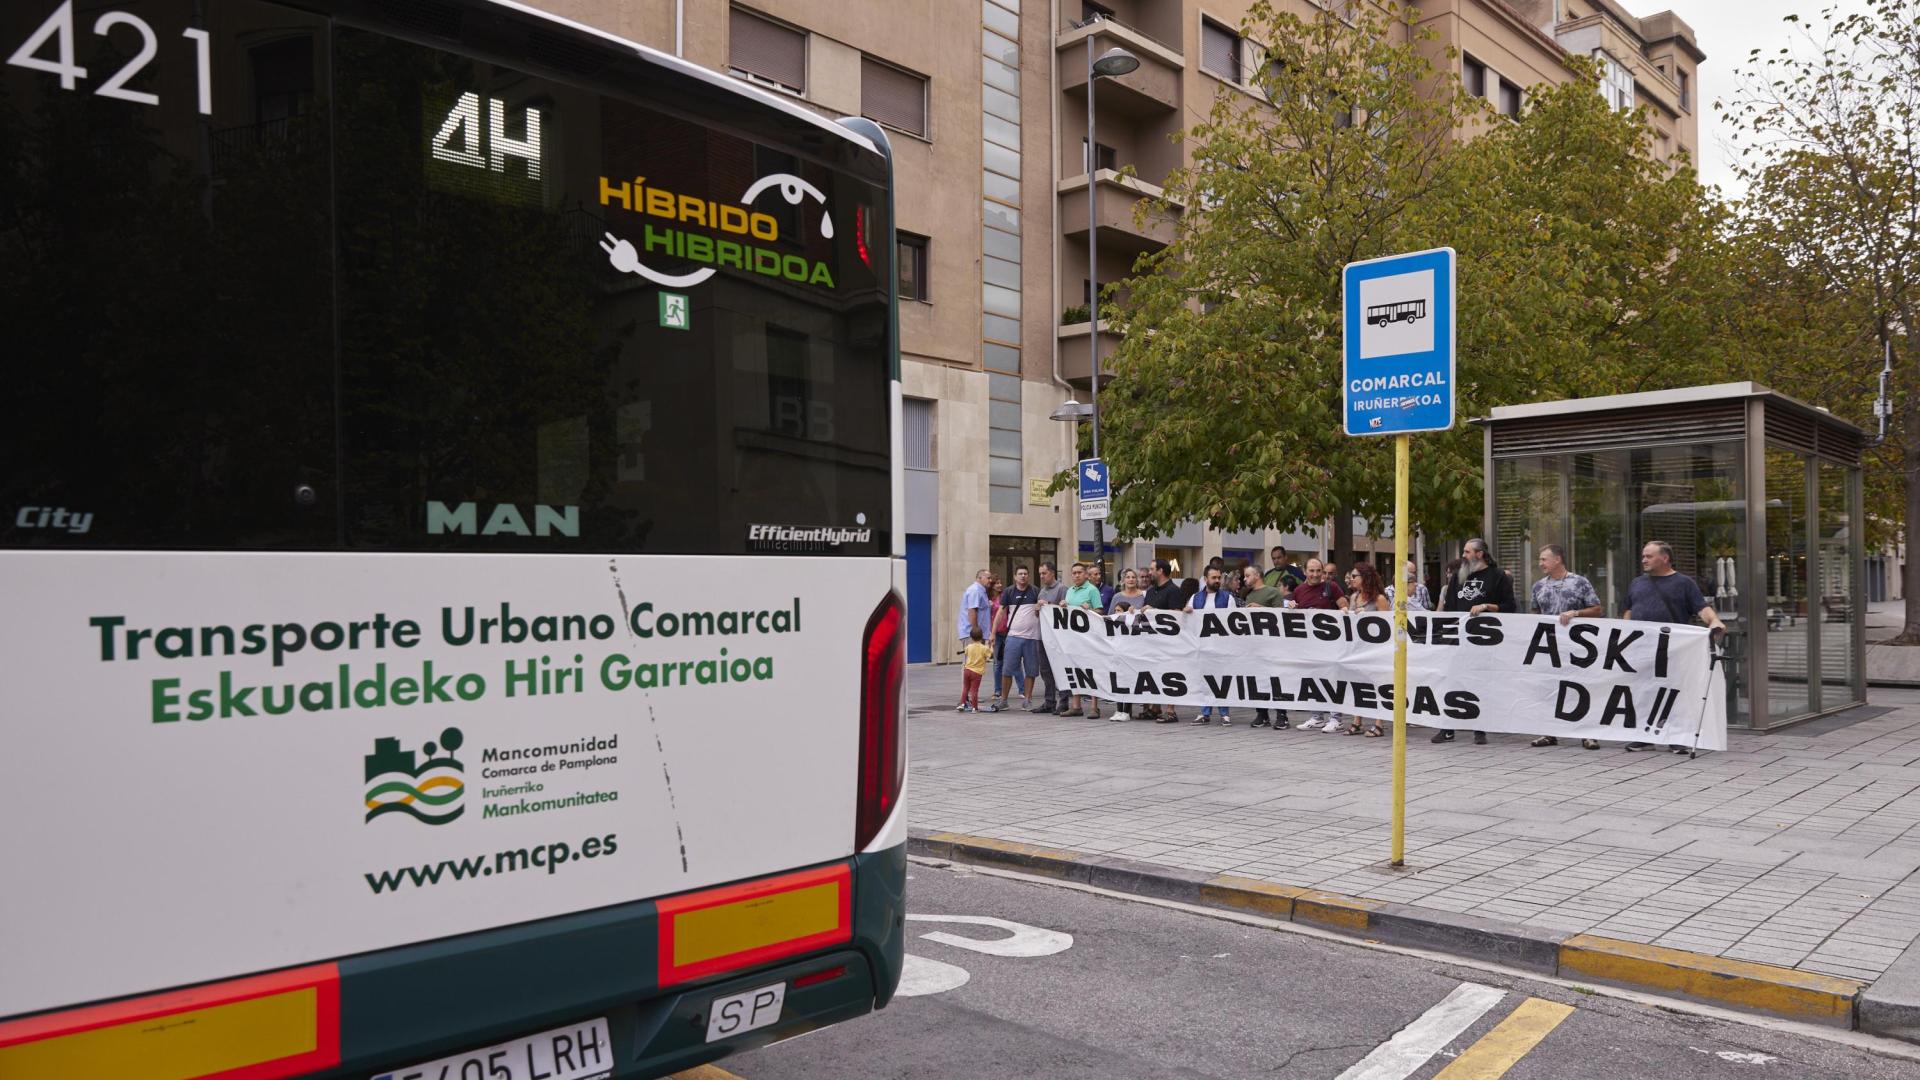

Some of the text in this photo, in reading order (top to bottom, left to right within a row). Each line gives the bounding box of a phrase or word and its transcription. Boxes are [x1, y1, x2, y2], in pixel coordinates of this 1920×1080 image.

[7, 0, 213, 115] 421
[431, 91, 541, 181] 4H
[599, 176, 778, 241] HÍBRIDO
[644, 224, 836, 289] HIBRIDOA
[1350, 371, 1446, 393] COMARCAL
[15, 506, 94, 533] City
[426, 500, 580, 537] MAN
[748, 524, 872, 545] EfficientHybrid
[89, 597, 801, 667] Transporte Urbano Comarcal
[1053, 608, 1090, 633] NO
[1199, 611, 1504, 646] AGRESIONES
[152, 647, 774, 723] Eskualdeko Hiri Garraioa
[1065, 667, 1098, 690] EN
[1109, 671, 1188, 697] LAS
[1555, 680, 1681, 736] DA!!
[482, 734, 618, 763] Mancomunidad
[482, 753, 618, 780] Comarca de Pamplona
[482, 780, 544, 798] Iruñerriko
[482, 789, 618, 819] Mankomunitatea
[365, 834, 618, 894] www.mcp.es
[718, 992, 777, 1033] SP
[526, 1026, 601, 1080] LRH
